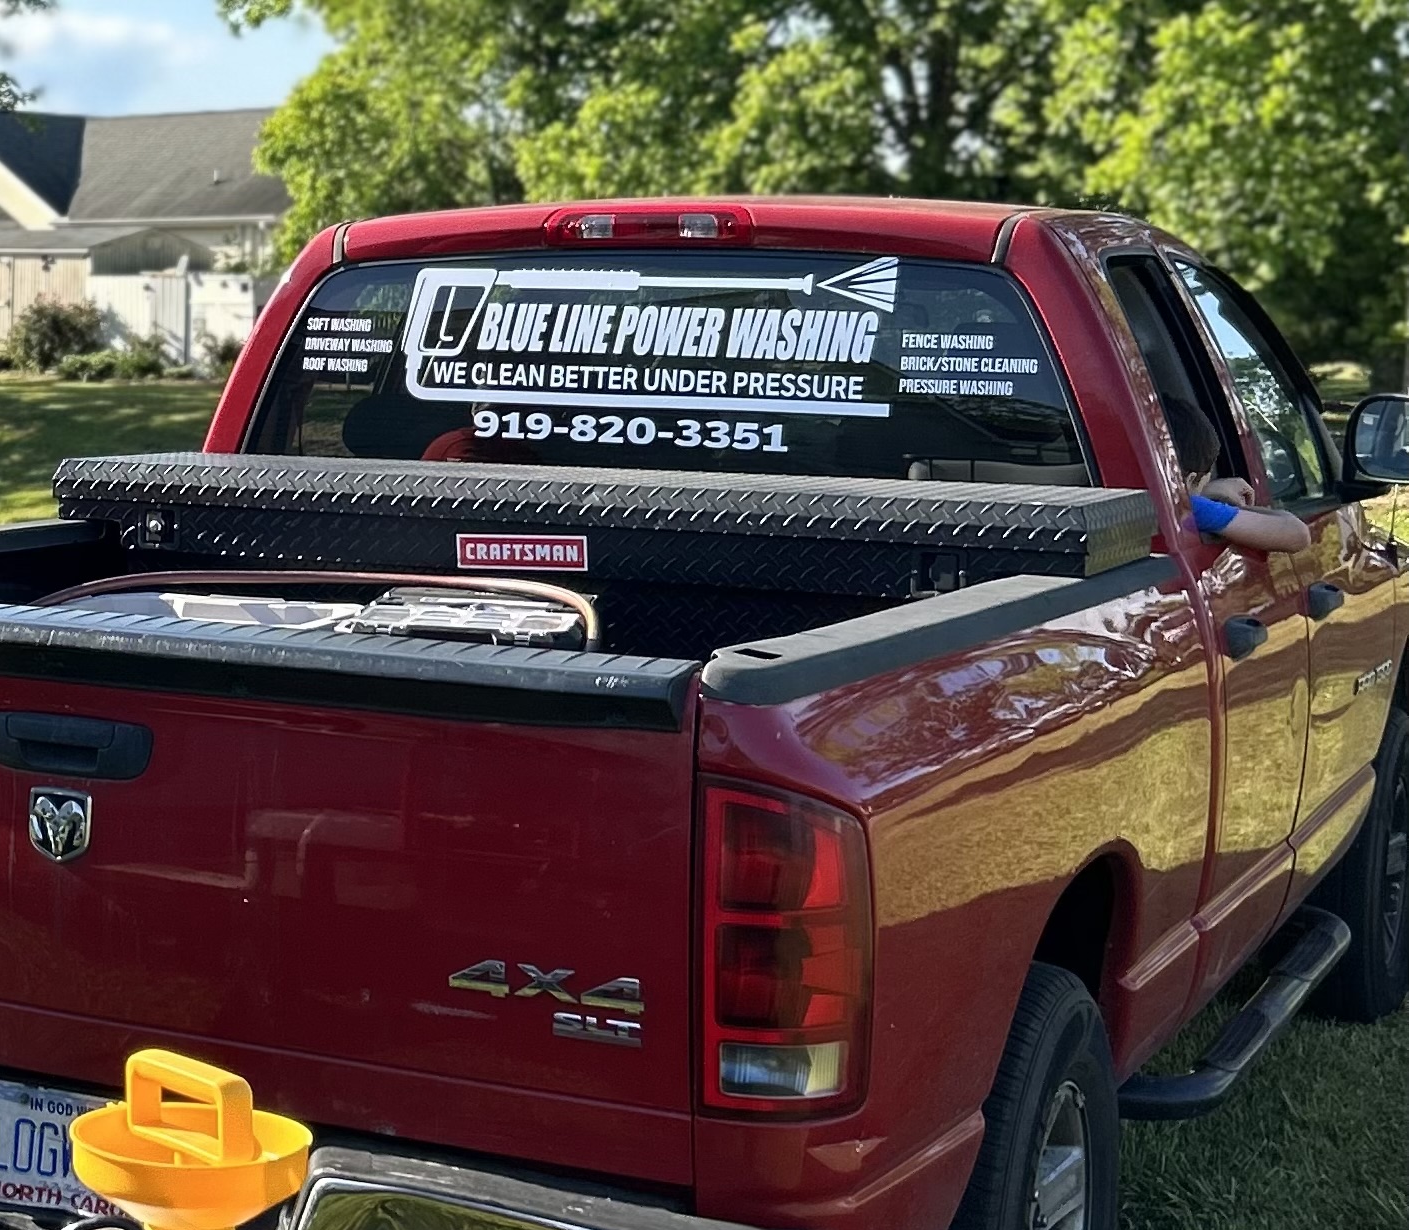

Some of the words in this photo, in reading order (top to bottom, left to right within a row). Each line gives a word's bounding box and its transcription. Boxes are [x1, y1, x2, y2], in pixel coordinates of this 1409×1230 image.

[307, 317, 330, 331] SOFT
[330, 318, 371, 332] WASHING
[477, 303, 553, 351] BLUE
[548, 304, 618, 355] LINE
[613, 305, 725, 358] POWER
[726, 308, 879, 363] WASHING
[305, 337, 350, 352] DRIVEWAY
[351, 339, 393, 354] WASHING
[902, 333, 938, 350] FENCE
[939, 334, 993, 350] WASHING
[303, 357, 327, 371] ROOF
[327, 358, 368, 373] WASHING
[900, 356, 978, 373] BRICK/STONE
[980, 357, 1038, 374] CLEANING
[433, 361, 468, 385] WE
[471, 363, 545, 387] CLEAN
[550, 364, 638, 391] BETTER
[644, 367, 727, 394] UNDER
[732, 371, 865, 400] PRESSURE
[898, 378, 958, 395] PRESSURE
[959, 380, 1013, 396] WASHING
[473, 411, 788, 453] 919-820-3351
[465, 542, 579, 562] CRAFTSMAN
[553, 1012, 642, 1047] SLT
[30, 1098, 43, 1112] IN
[47, 1101, 73, 1116] GOD
